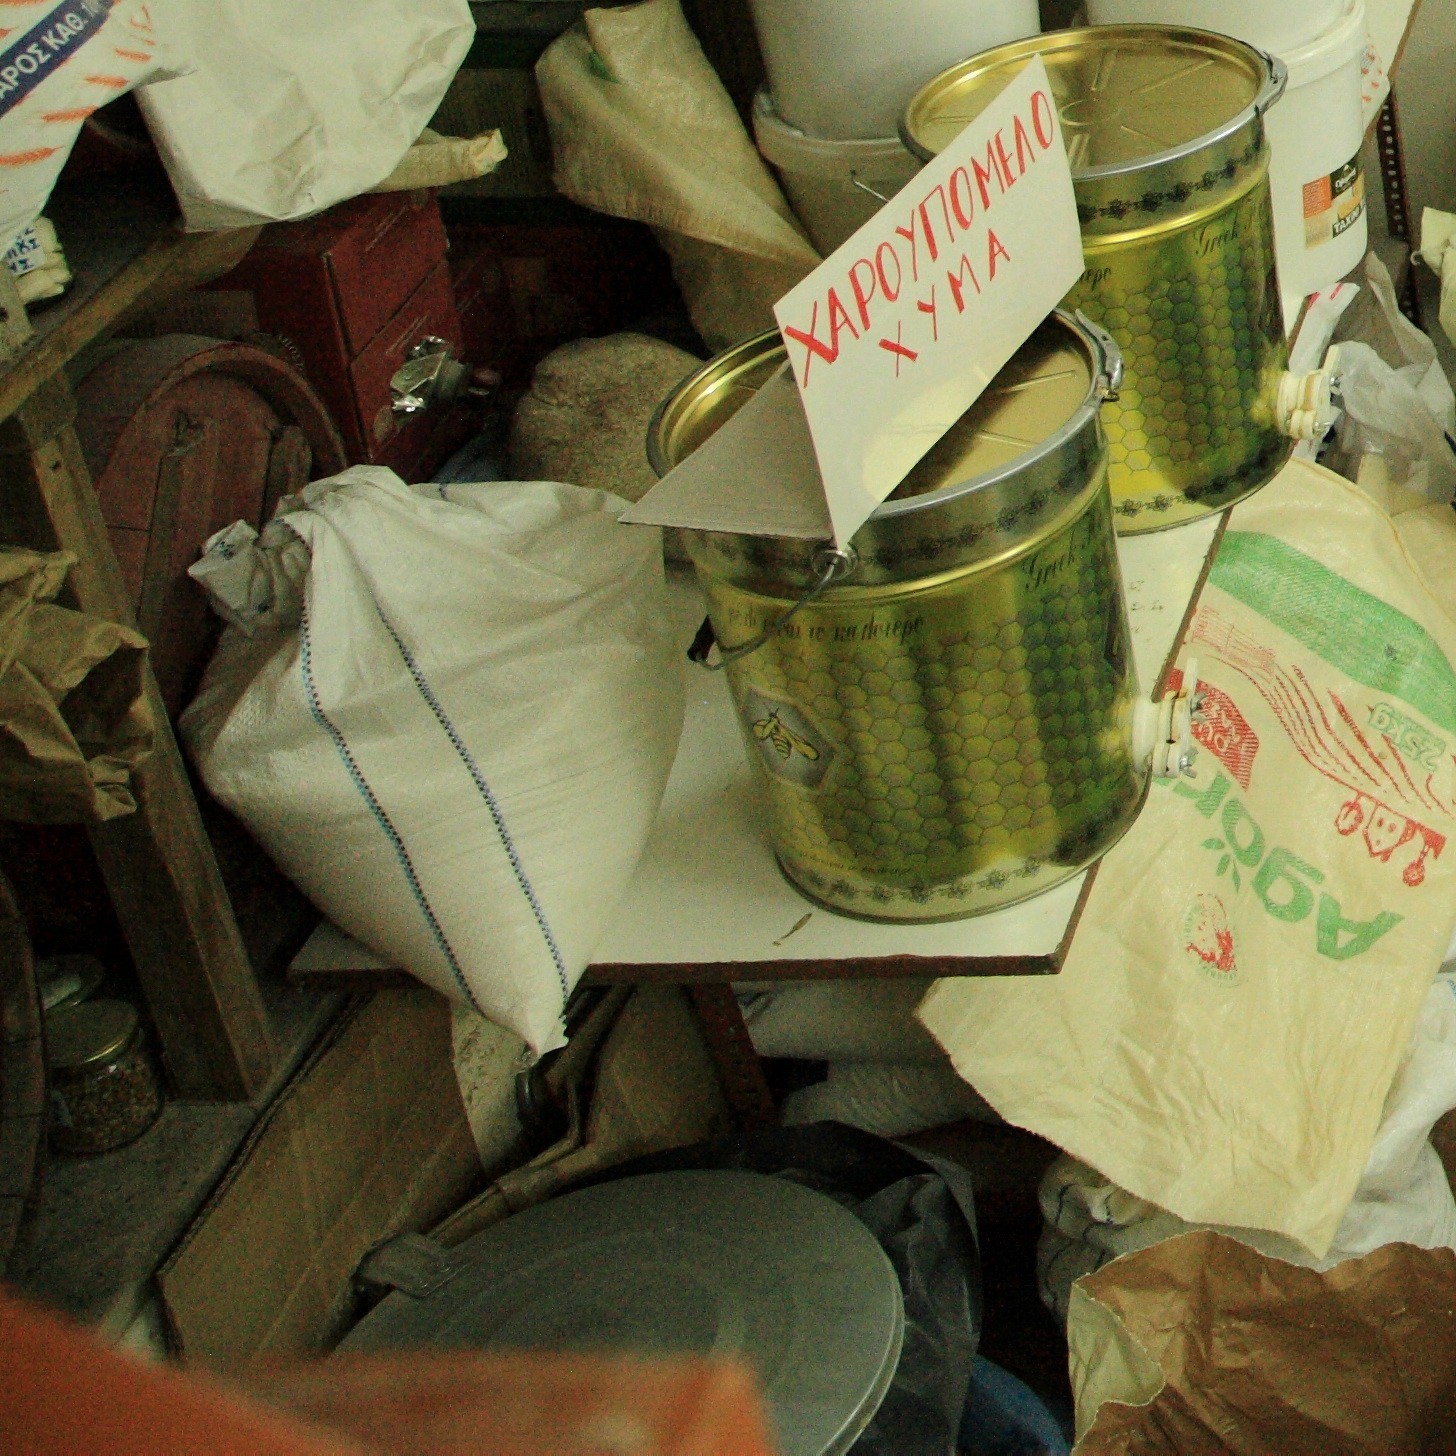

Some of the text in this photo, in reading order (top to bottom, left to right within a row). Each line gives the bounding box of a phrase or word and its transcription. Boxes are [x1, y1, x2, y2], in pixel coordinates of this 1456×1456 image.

[41, 10, 88, 61] ΚΑΘ.
[784, 90, 1053, 389] ΧΑΡΟΥΠΟΜΕΛΟ
[878, 228, 1010, 378] ΧΥΜΑ
[1152, 770, 1405, 961] Agor
